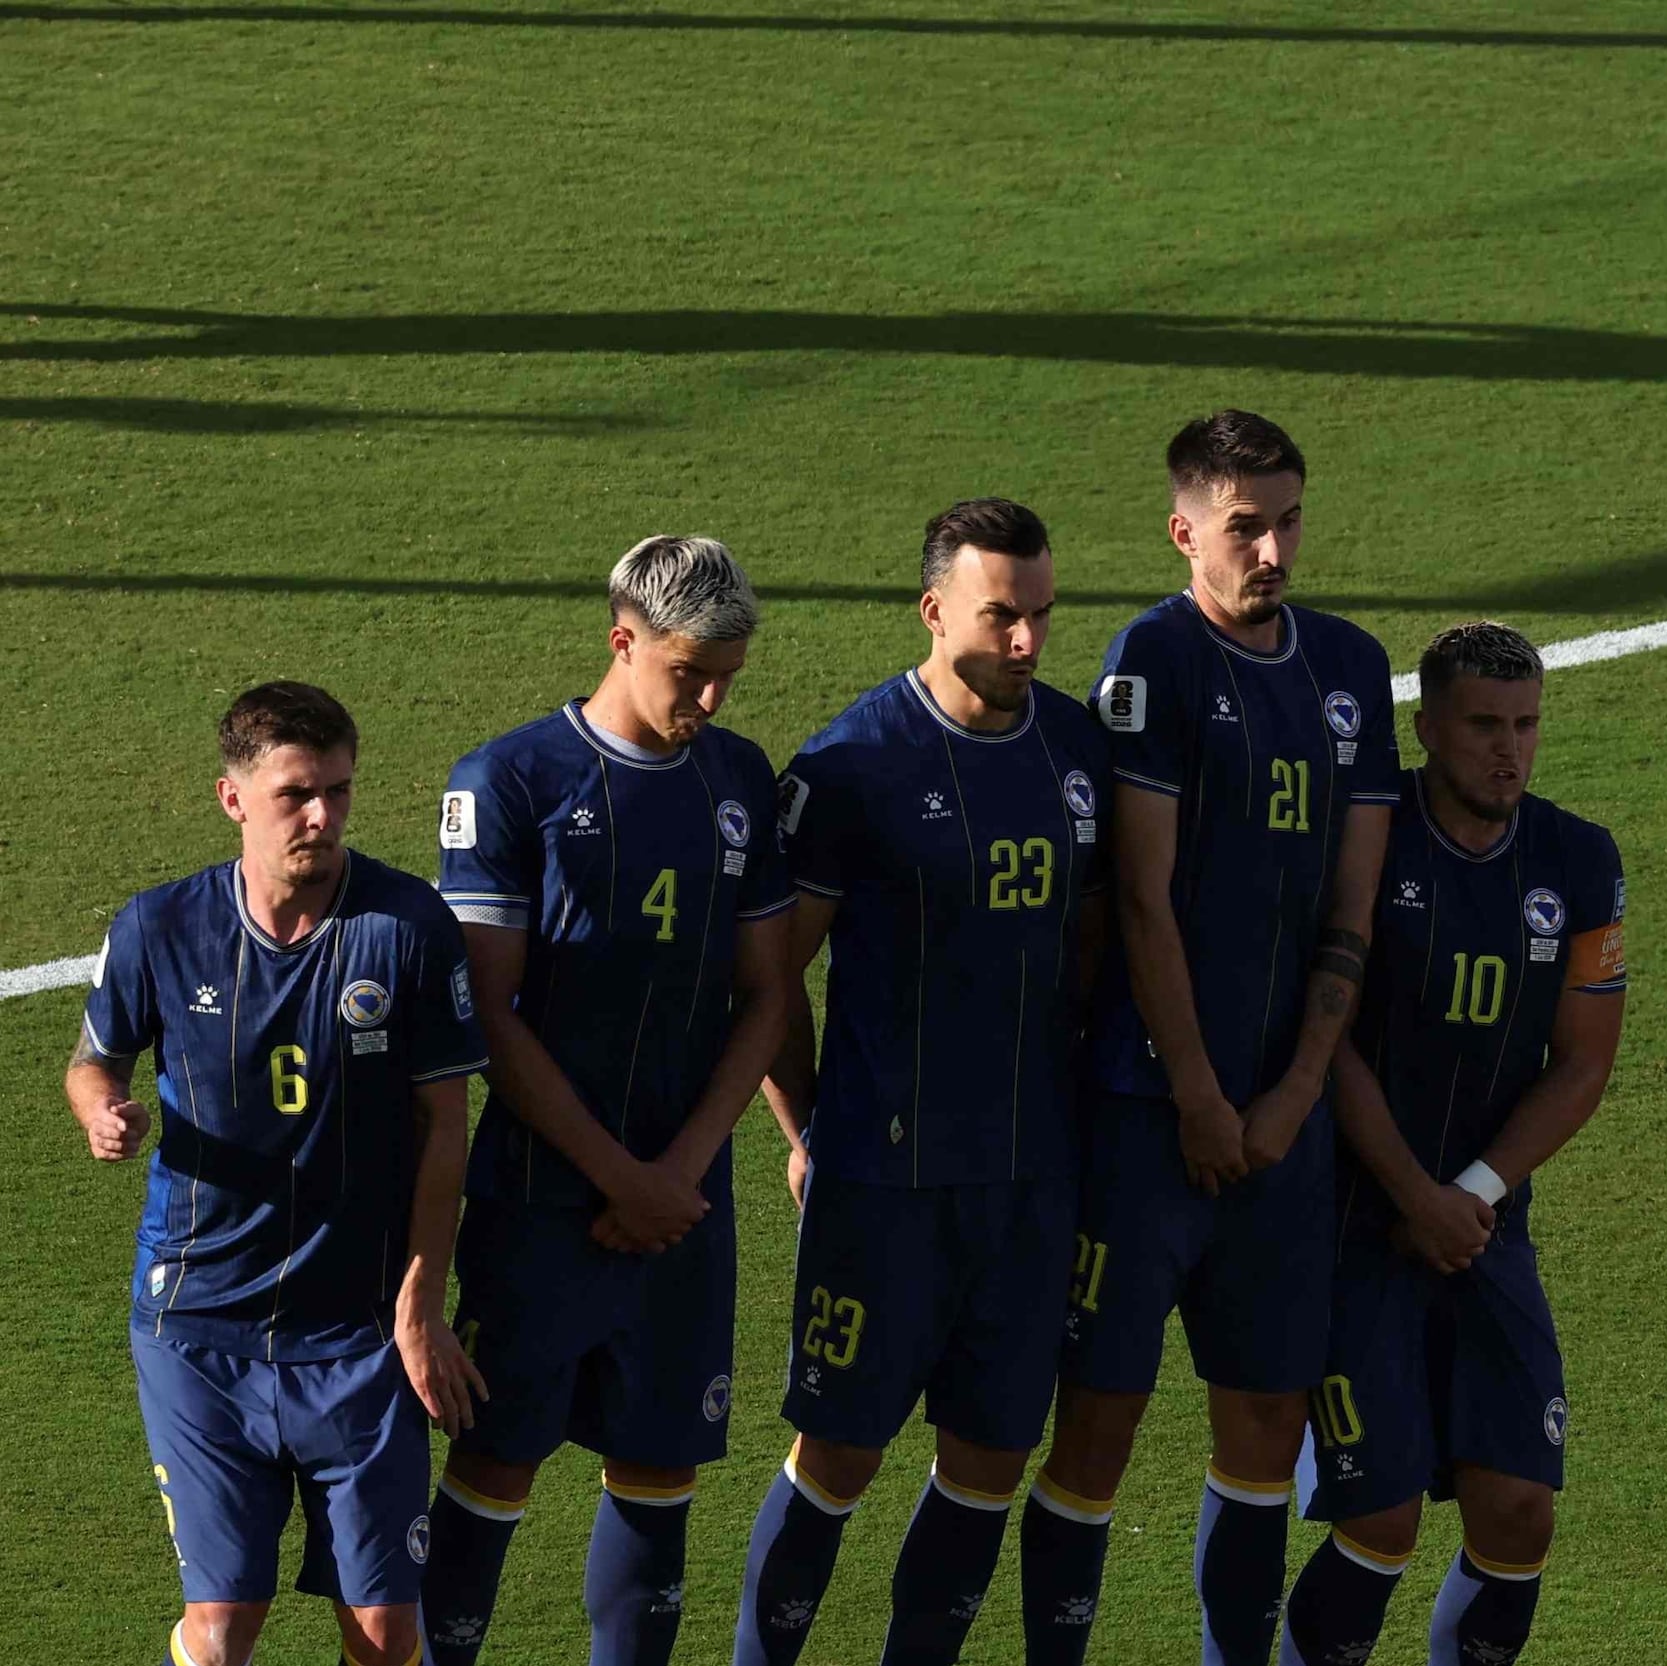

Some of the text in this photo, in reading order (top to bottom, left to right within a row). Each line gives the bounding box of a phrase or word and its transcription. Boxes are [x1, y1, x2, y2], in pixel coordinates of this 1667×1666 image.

[1211, 711, 1240, 722] KELME
[920, 810, 953, 821] KELME
[1267, 757, 1312, 834] 21
[568, 827, 602, 838] KELME
[640, 867, 680, 944] 4
[988, 836, 1055, 911] 23
[1392, 898, 1426, 910] KELME
[188, 1003, 223, 1016] KELME
[1444, 952, 1508, 1027] 10
[269, 1043, 310, 1116] 6
[802, 1284, 867, 1371] 23
